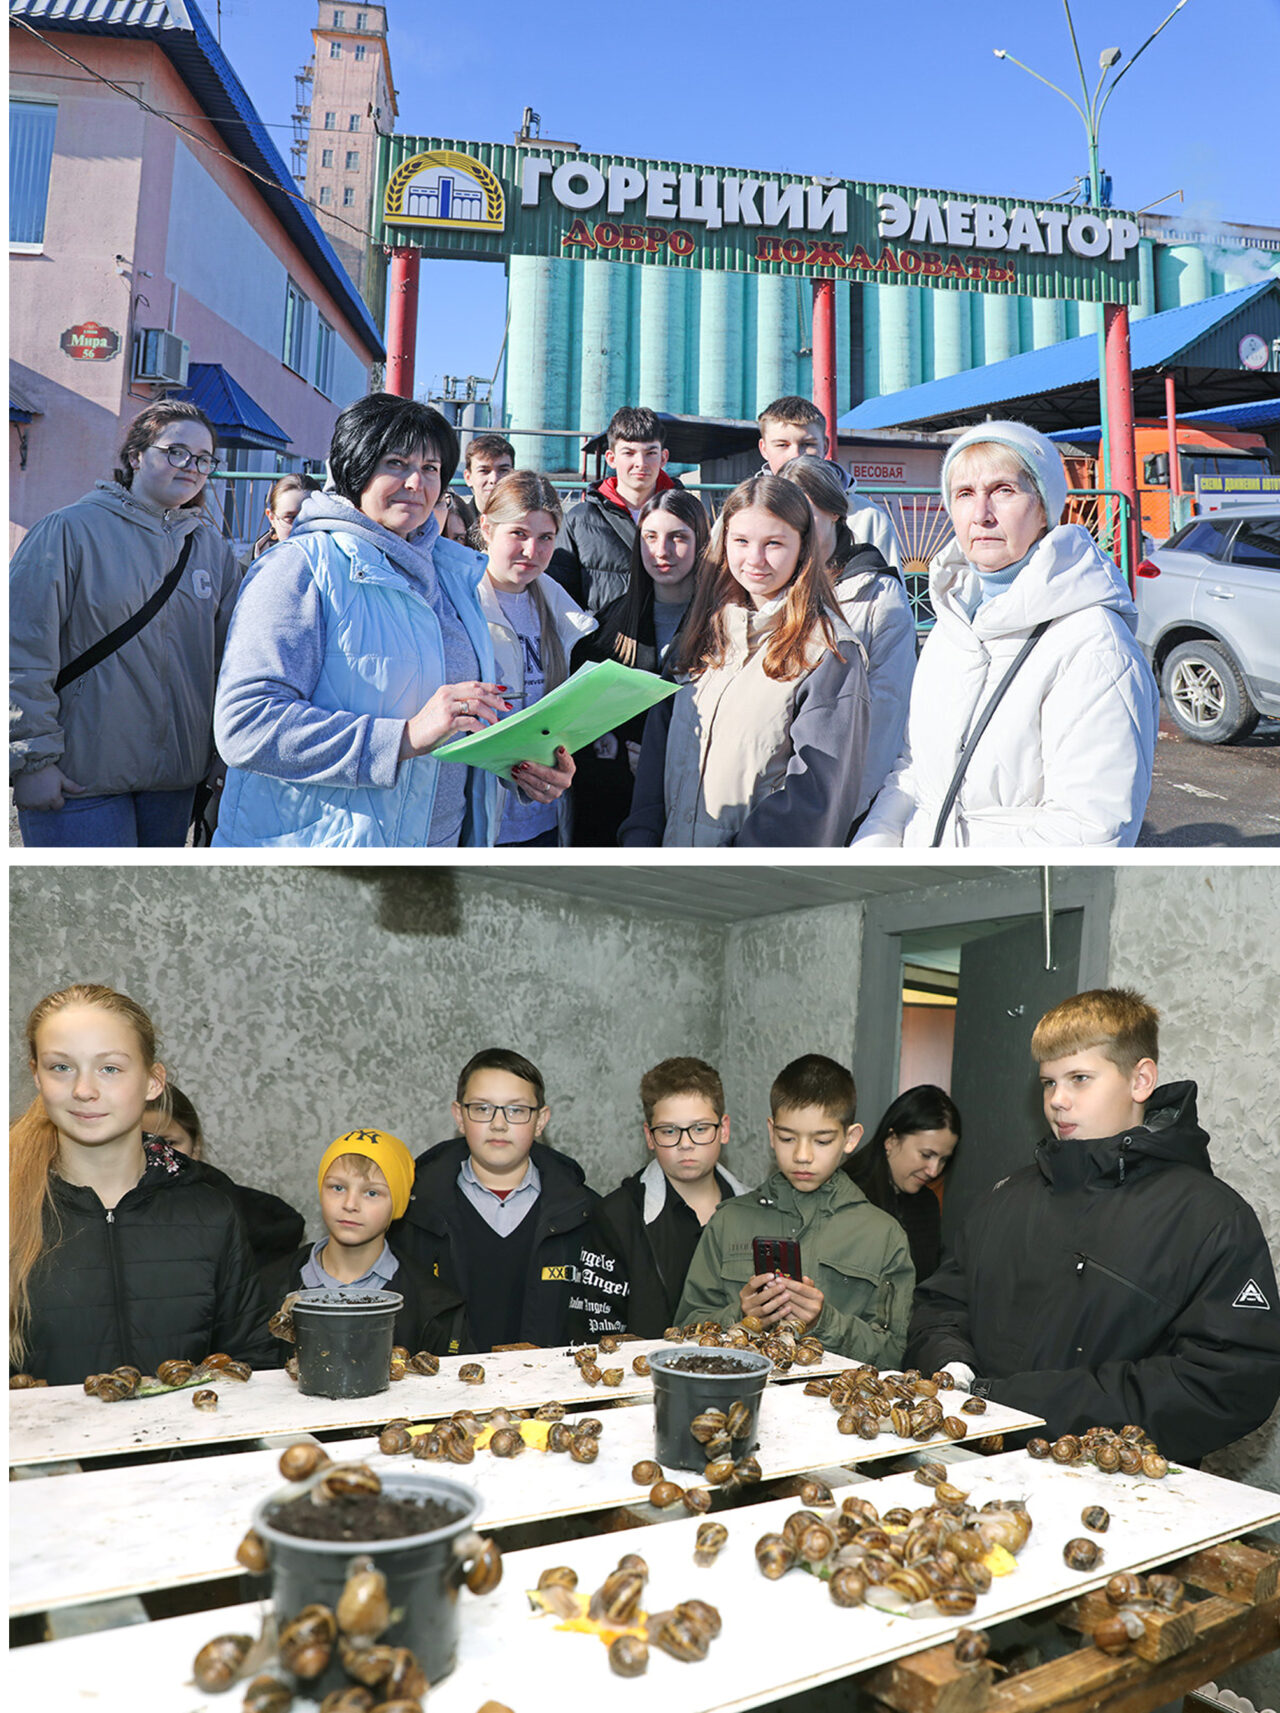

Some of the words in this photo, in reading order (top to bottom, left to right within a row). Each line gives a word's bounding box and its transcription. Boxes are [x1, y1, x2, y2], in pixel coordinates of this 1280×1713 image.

[521, 156, 847, 234] ГОРЕЦКИЙ
[878, 192, 1140, 261] ЭЛЕВАТОР
[562, 218, 696, 256] ДОБРО
[755, 236, 1017, 283] ПОЖАЛОВАТЬ!
[71, 334, 108, 348] Мира
[82, 349, 95, 359] 56
[853, 465, 903, 478] ВЕСОВАЯ
[1201, 478, 1223, 490] СХЕМА
[1225, 478, 1260, 492] ДВИЖЕНИЯ
[191, 569, 211, 599] C
[581, 1247, 615, 1272] ngels
[582, 1268, 630, 1297] Angel
